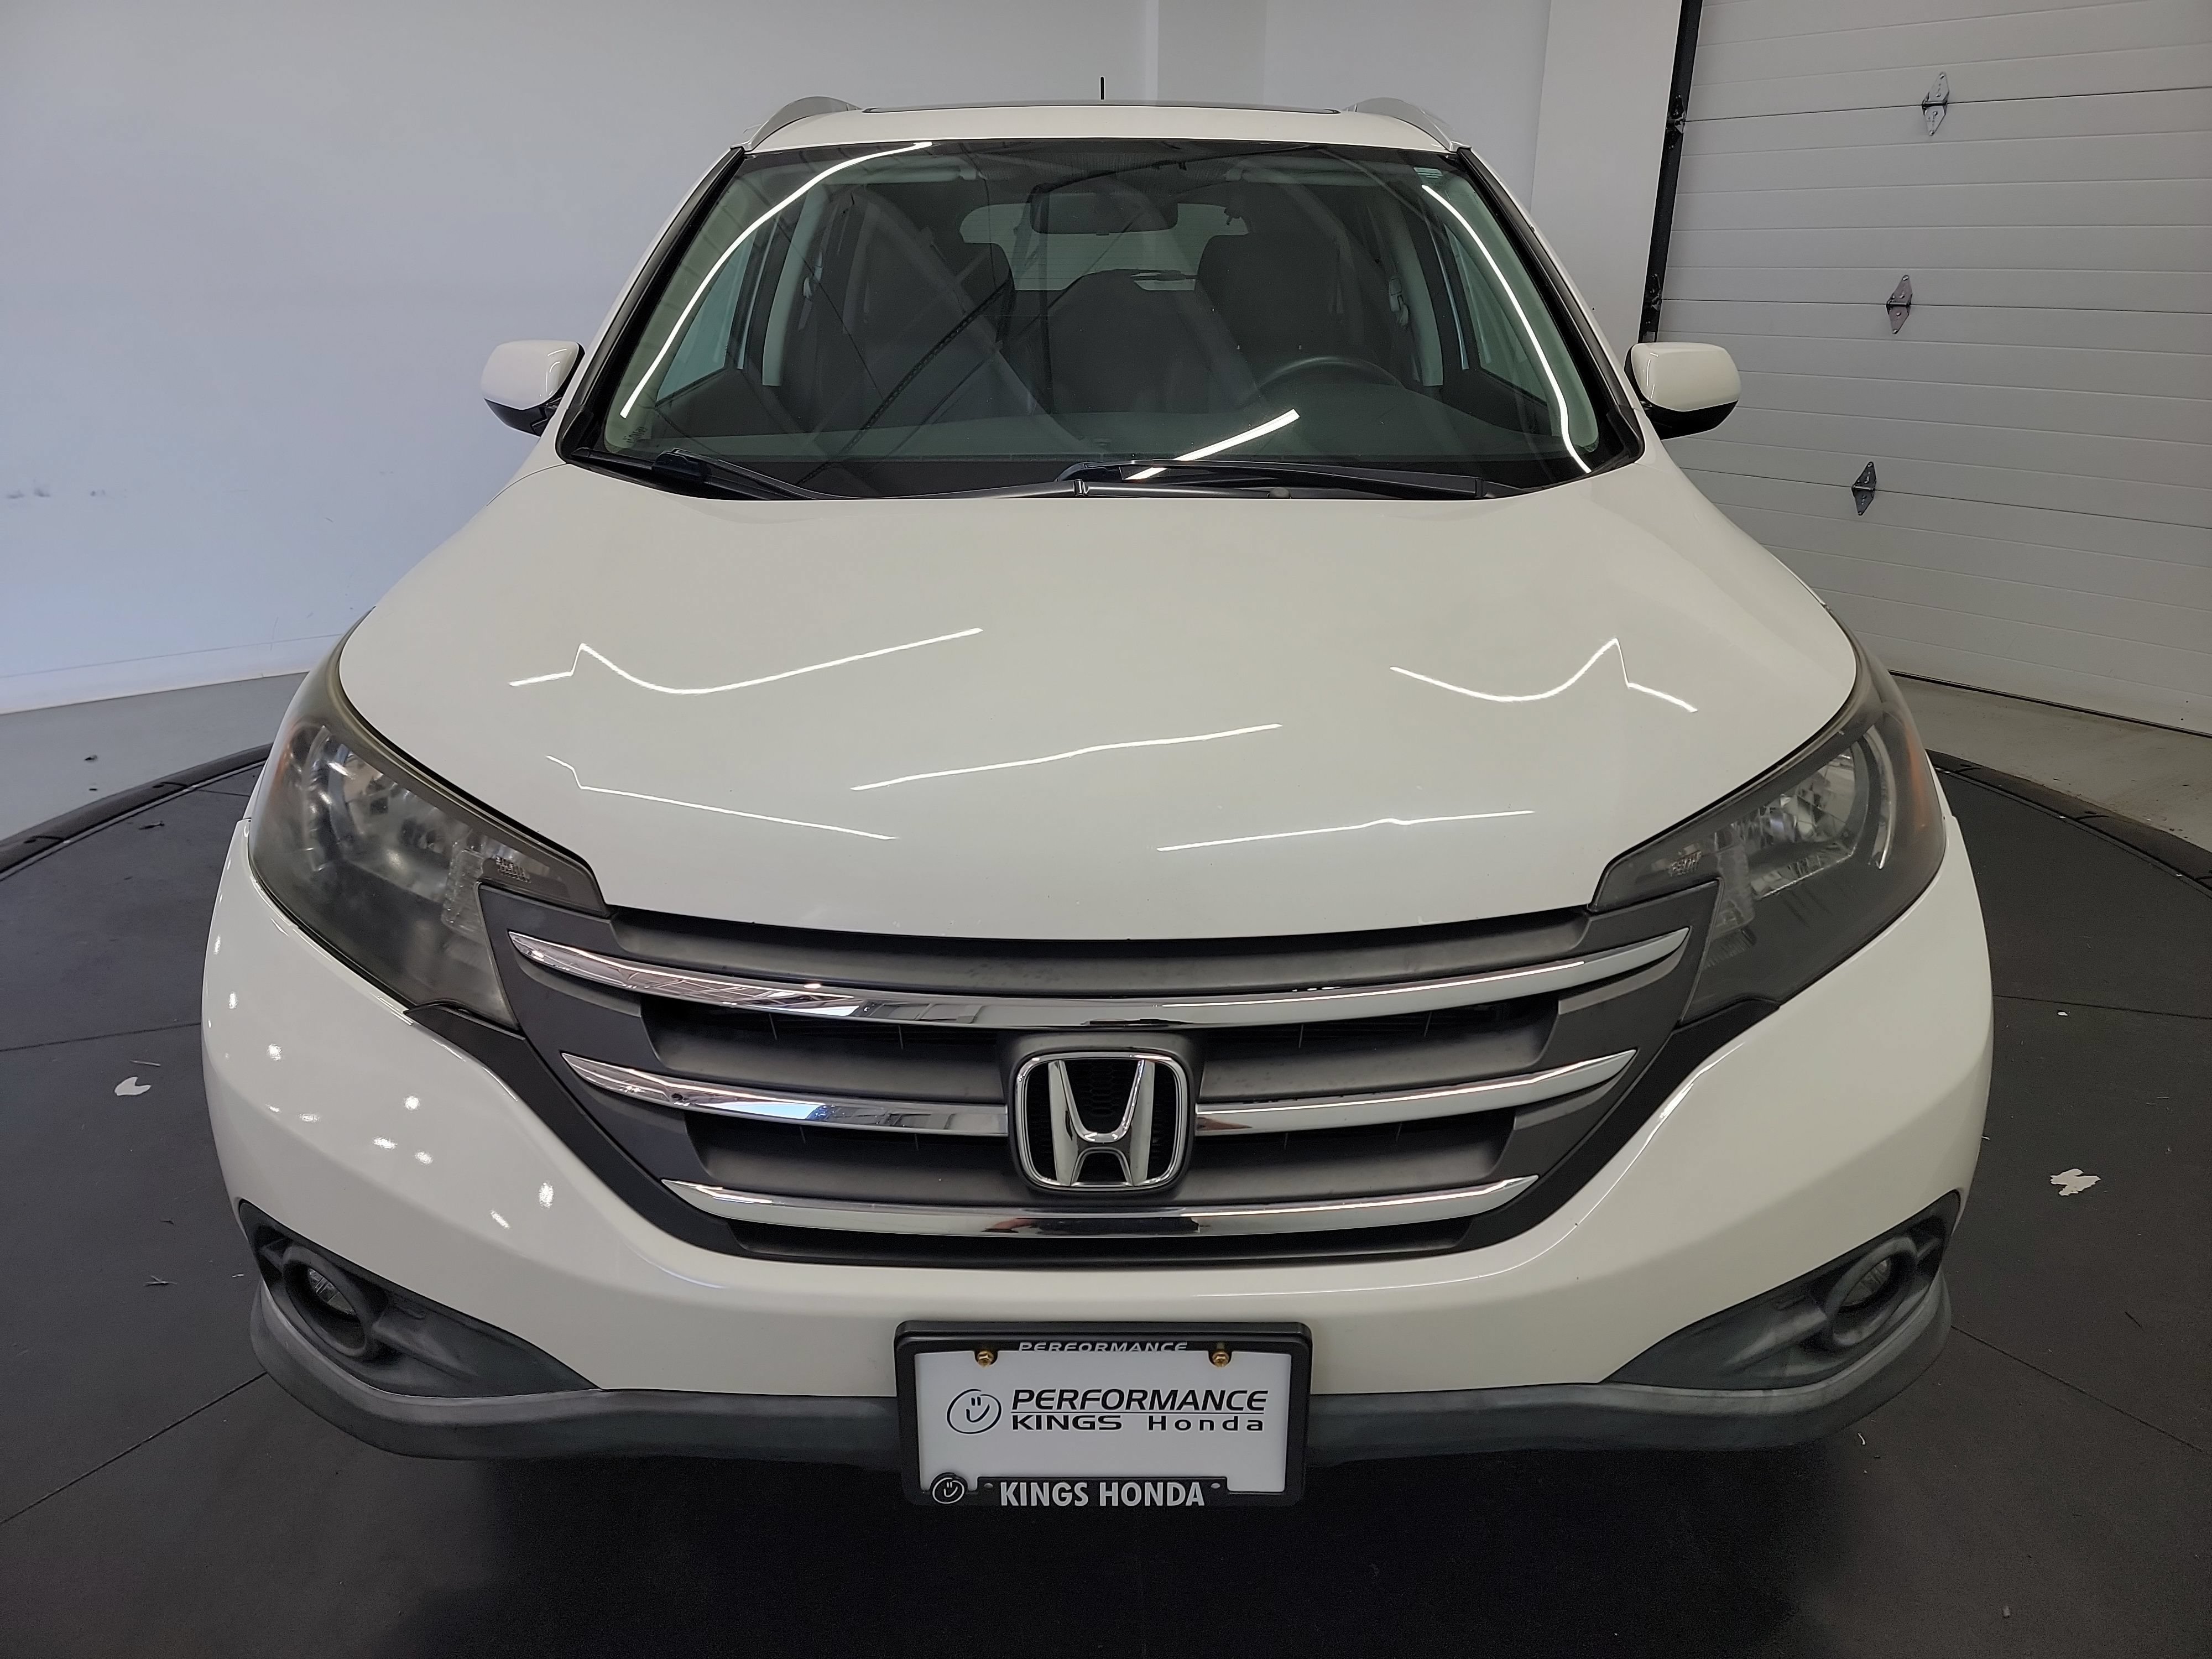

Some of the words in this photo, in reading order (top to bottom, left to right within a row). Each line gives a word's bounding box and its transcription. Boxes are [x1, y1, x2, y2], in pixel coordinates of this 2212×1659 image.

[1018, 1342, 1188, 1352] PERFORMANCE
[1011, 1389, 1269, 1411] PERFORMANCE
[1011, 1415, 1123, 1431] KINGS
[1148, 1415, 1263, 1431] Honda
[1000, 1481, 1089, 1506] KINGS
[1099, 1481, 1205, 1506] HONDA
